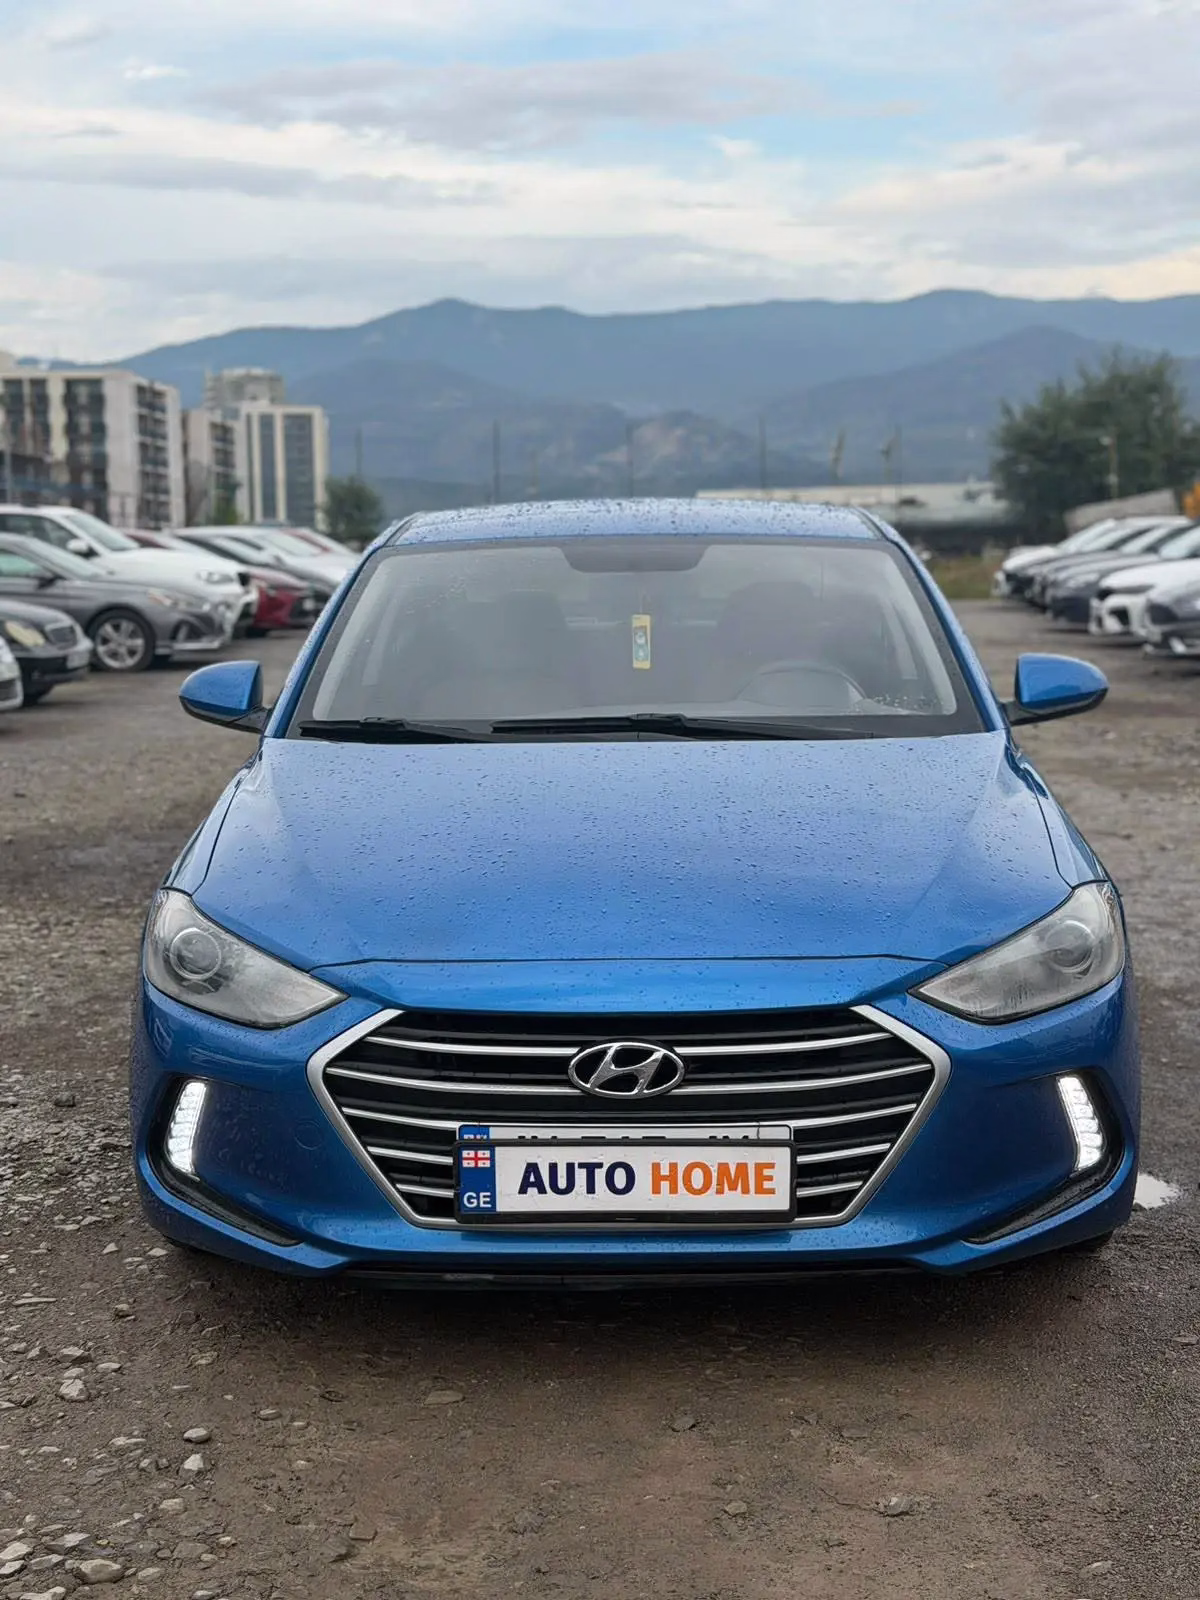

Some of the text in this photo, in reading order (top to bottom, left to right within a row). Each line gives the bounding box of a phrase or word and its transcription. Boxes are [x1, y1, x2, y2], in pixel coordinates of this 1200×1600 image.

[517, 1161, 776, 1196] AUTO HOME
[463, 1191, 492, 1208] GE
